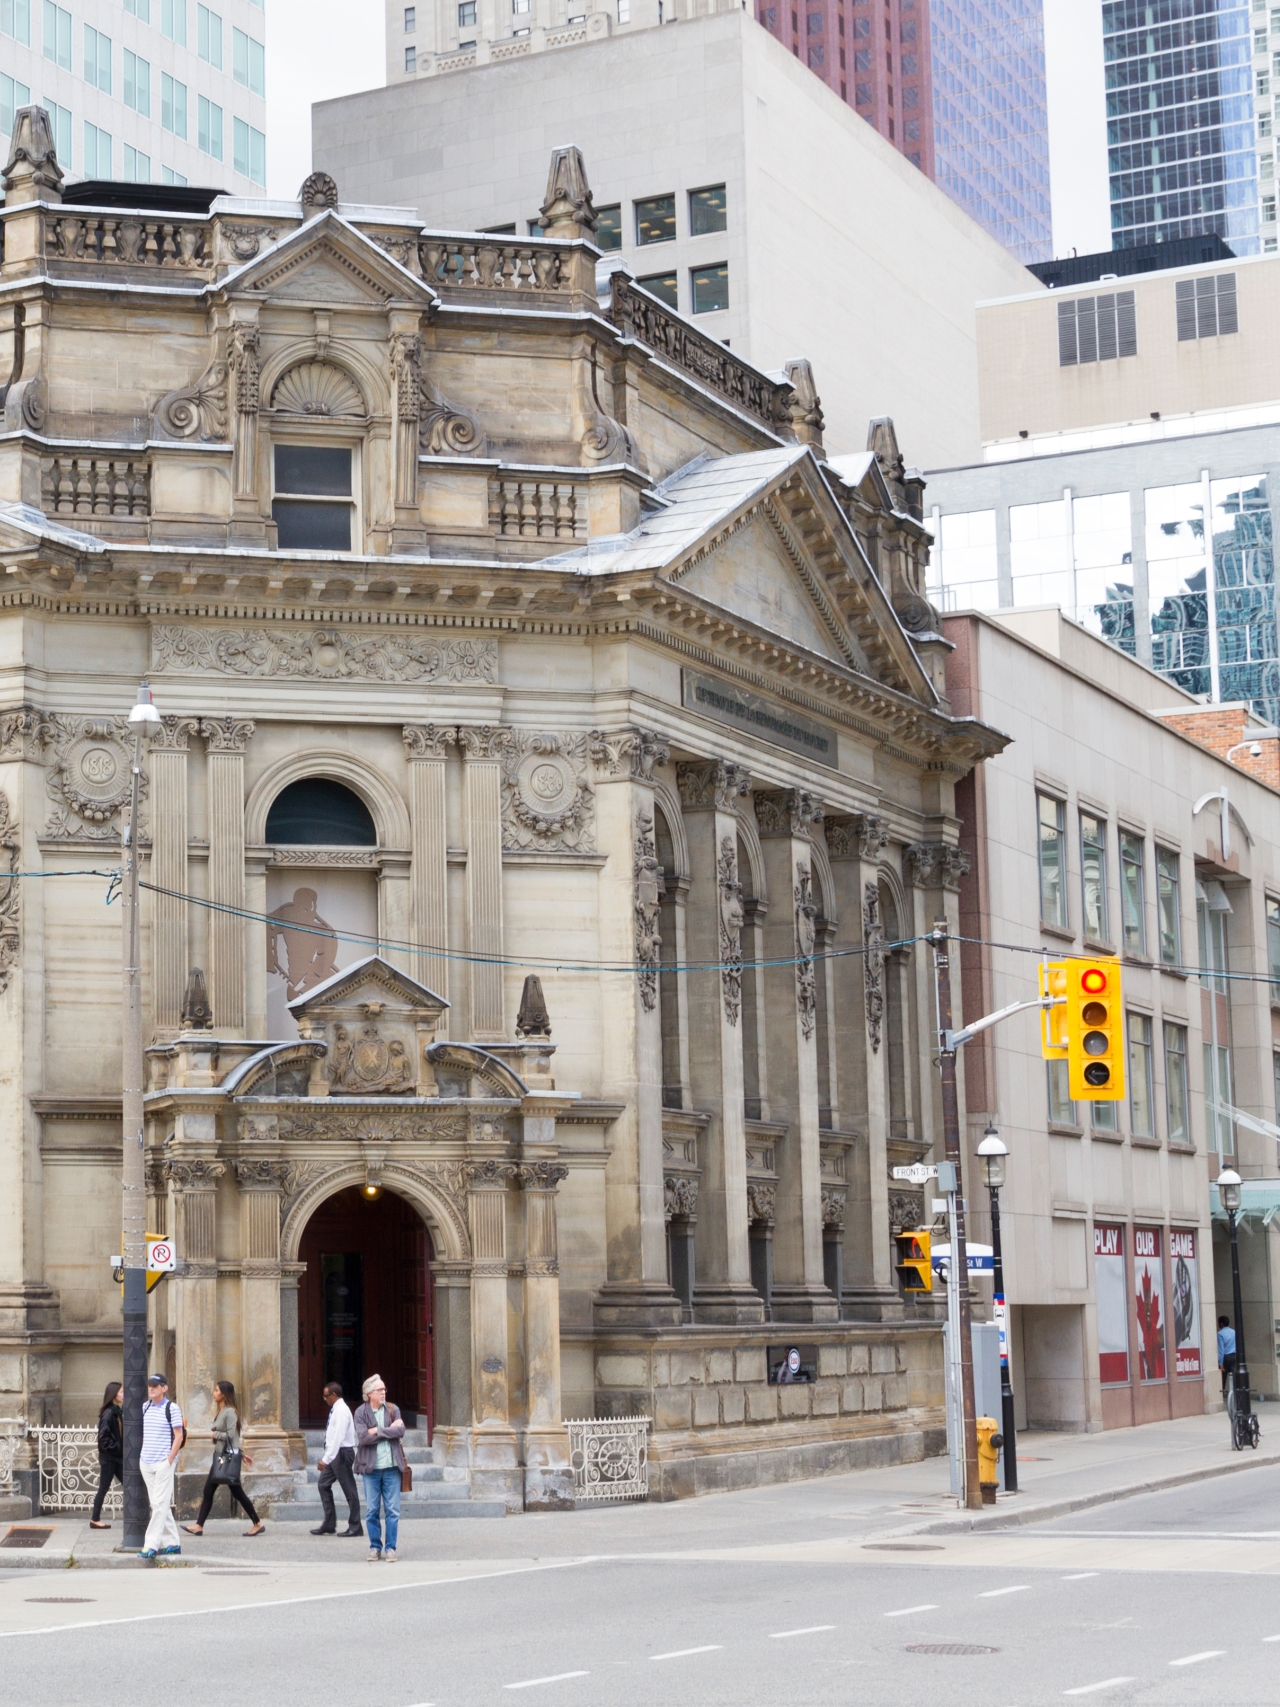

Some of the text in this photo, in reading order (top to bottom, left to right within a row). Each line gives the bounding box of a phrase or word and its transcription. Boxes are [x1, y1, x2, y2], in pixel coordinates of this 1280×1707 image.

[896, 1167, 920, 1177] FRONT
[1094, 1228, 1118, 1254] PLAY
[1135, 1231, 1155, 1255] OUR
[1169, 1233, 1193, 1257] GAME
[966, 1258, 983, 1268] St W
